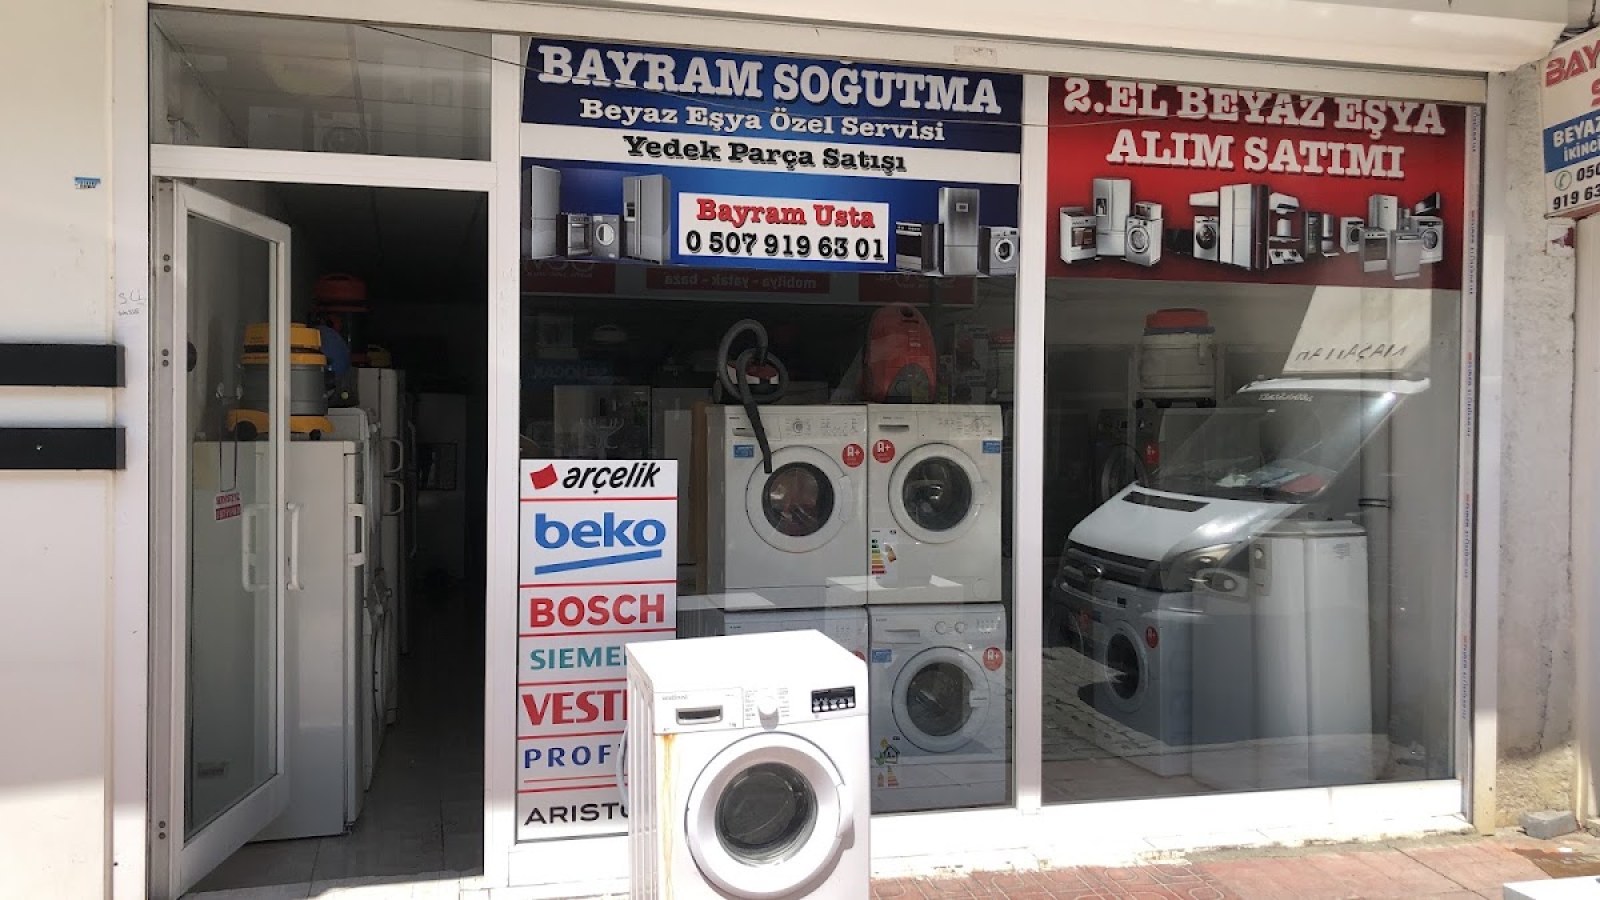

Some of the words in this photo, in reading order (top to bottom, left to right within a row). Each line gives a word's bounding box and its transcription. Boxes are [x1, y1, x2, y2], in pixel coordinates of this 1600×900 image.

[539, 45, 762, 99] BAYRAM
[773, 59, 1001, 115] SOĞUTMA
[580, 98, 677, 128] Beyaz
[686, 106, 762, 135] Eşya
[769, 107, 835, 136] Özel
[841, 116, 946, 142] Servisi
[1064, 78, 1168, 117] 2.EL
[1176, 84, 1325, 129] BEYAZ
[1334, 97, 1446, 140] EŞYA
[623, 135, 722, 162] Yedek
[728, 142, 815, 171] Parça
[822, 148, 907, 174] Satışı
[1106, 129, 1235, 169] ALIM
[1243, 136, 1405, 178] SATIMI
[697, 199, 805, 230] Bayram
[815, 205, 875, 229] Usta
[1553, 191, 1580, 210] 919
[686, 231, 701, 253] 0
[709, 232, 757, 257] 507
[764, 234, 811, 257] 919
[818, 236, 849, 258] 63
[855, 238, 885, 260] 01
[562, 462, 660, 494] arçelik
[534, 512, 666, 549] beko
[530, 594, 665, 628] BOSCH
[530, 645, 628, 671] SIEME
[524, 743, 621, 769] PROF
